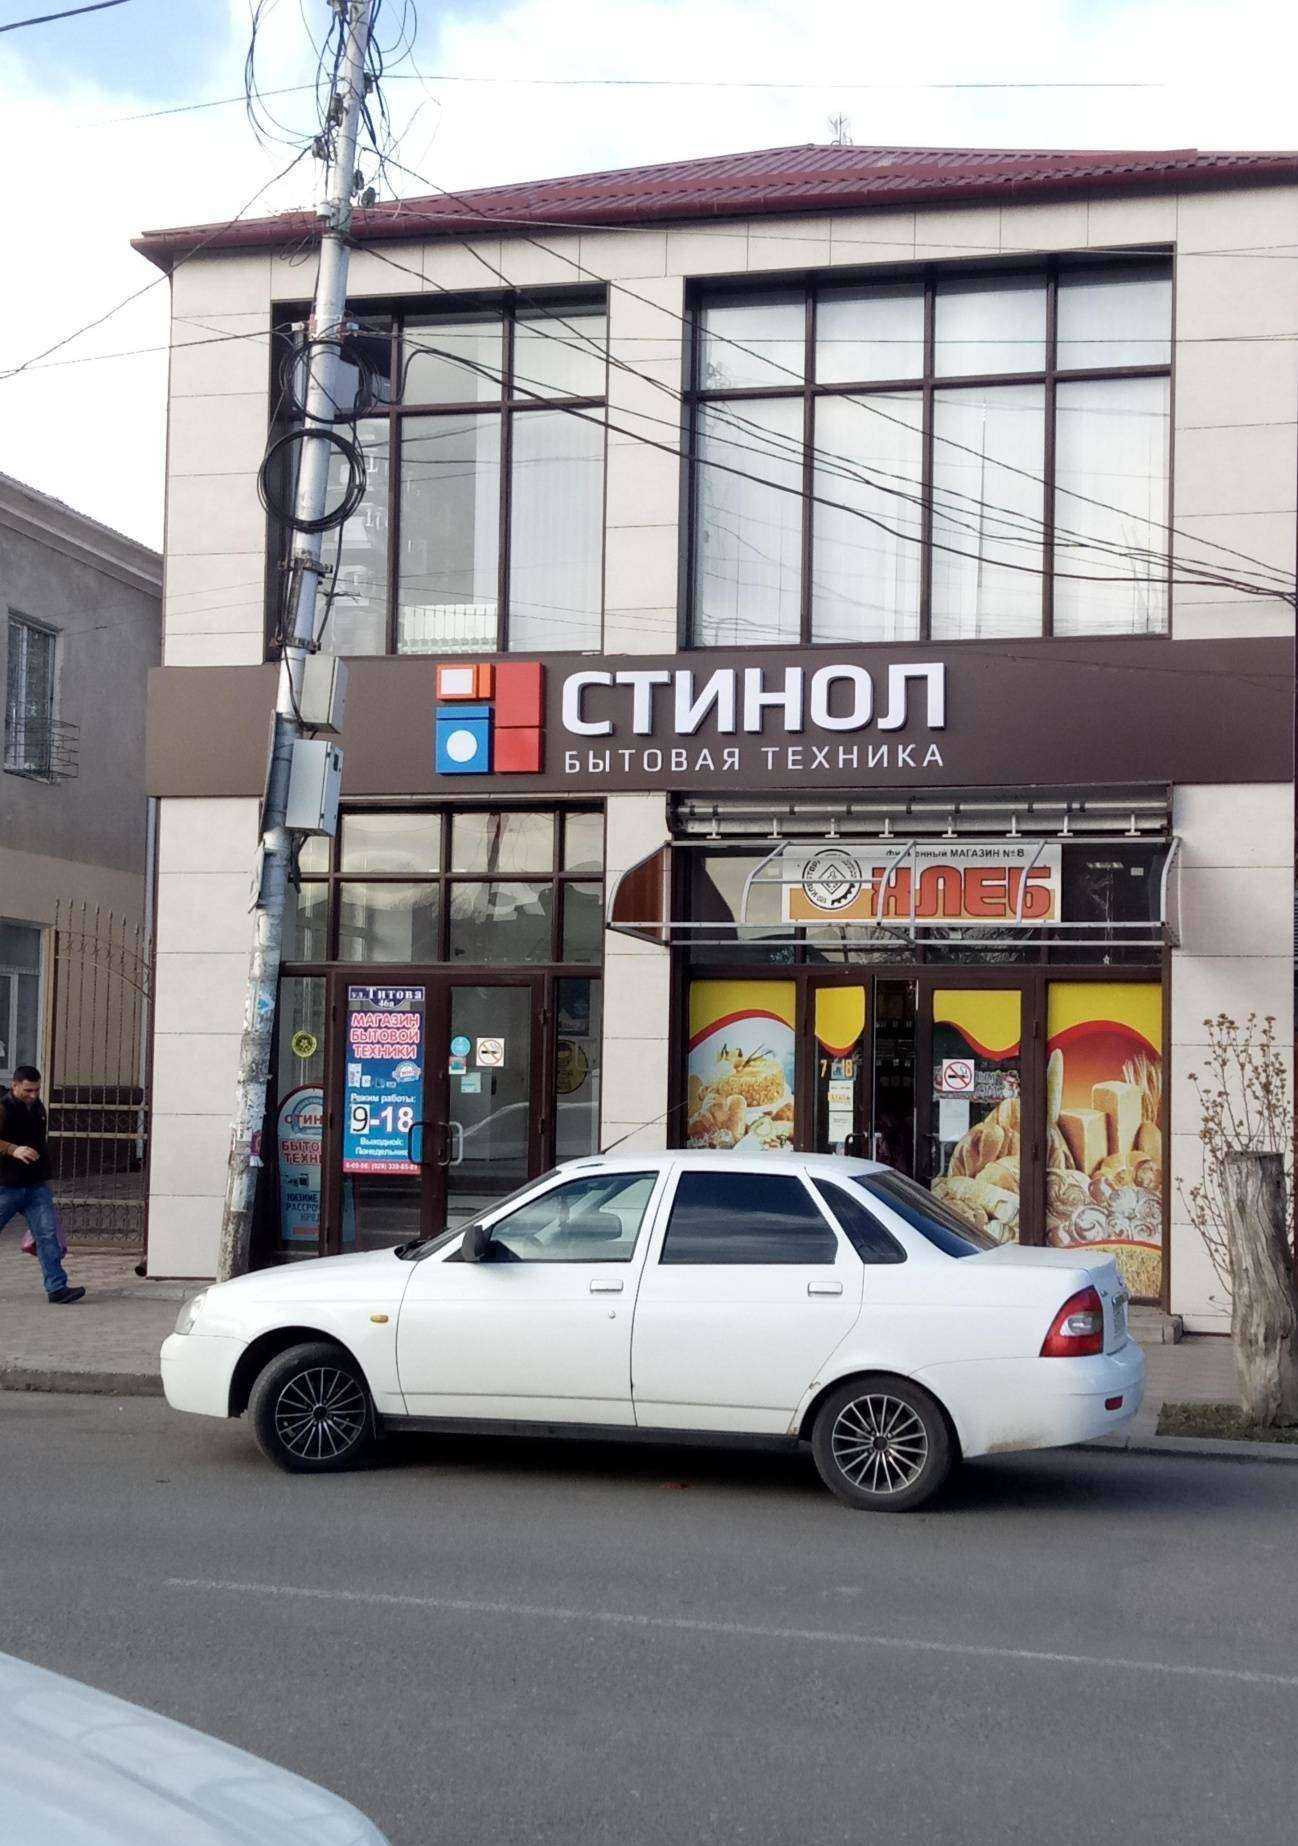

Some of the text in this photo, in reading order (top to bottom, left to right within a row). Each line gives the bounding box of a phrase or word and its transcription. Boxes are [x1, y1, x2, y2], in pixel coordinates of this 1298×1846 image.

[561, 662, 946, 736] СТИНОЛ
[564, 743, 945, 774] БЫТОВАЯ ТЕХНИКА
[950, 848, 1000, 858] МАГАЗИН
[351, 1012, 420, 1028] МАГАЗИН
[350, 1025, 420, 1043] БЫТОВОЙ
[352, 1043, 417, 1059] ТЕХНИКИ
[353, 1105, 414, 1133] 9-18
